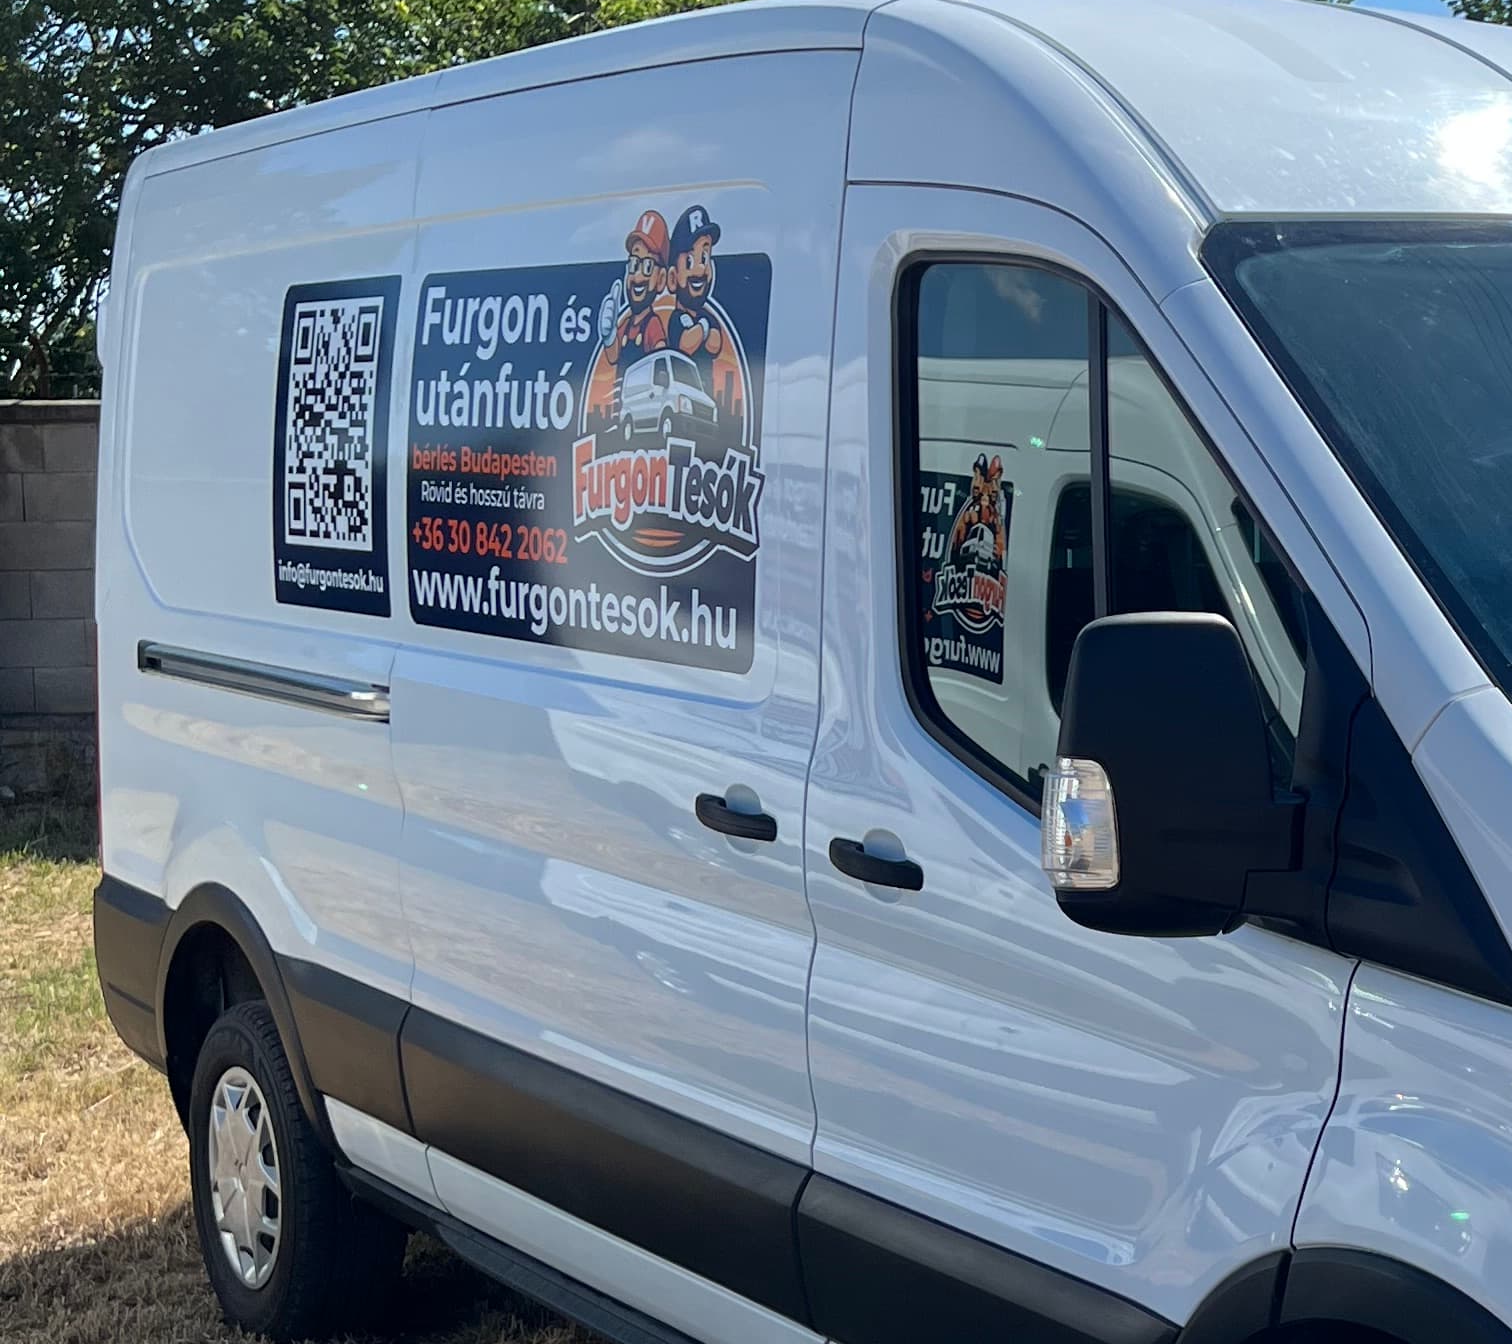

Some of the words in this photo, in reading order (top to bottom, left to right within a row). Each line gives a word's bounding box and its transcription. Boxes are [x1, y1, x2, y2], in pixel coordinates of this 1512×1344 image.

[642, 215, 655, 233] V
[689, 209, 703, 232] R
[422, 287, 547, 360] Furgon
[560, 297, 591, 343] és
[416, 362, 574, 430] utánfutó
[413, 442, 456, 472] bérlés
[461, 446, 557, 480] Budapesten
[421, 480, 452, 503] Rövid
[455, 483, 467, 504] és
[470, 482, 510, 508] hosszú
[513, 486, 545, 510] távra
[575, 437, 756, 539] FurgonTesók
[412, 517, 444, 551] +36
[448, 519, 470, 554] 30
[476, 522, 512, 558] 842
[517, 525, 567, 564] 2062
[278, 559, 384, 593] info@furgontesok.hu
[412, 566, 737, 650] www.furgontesok.hu
